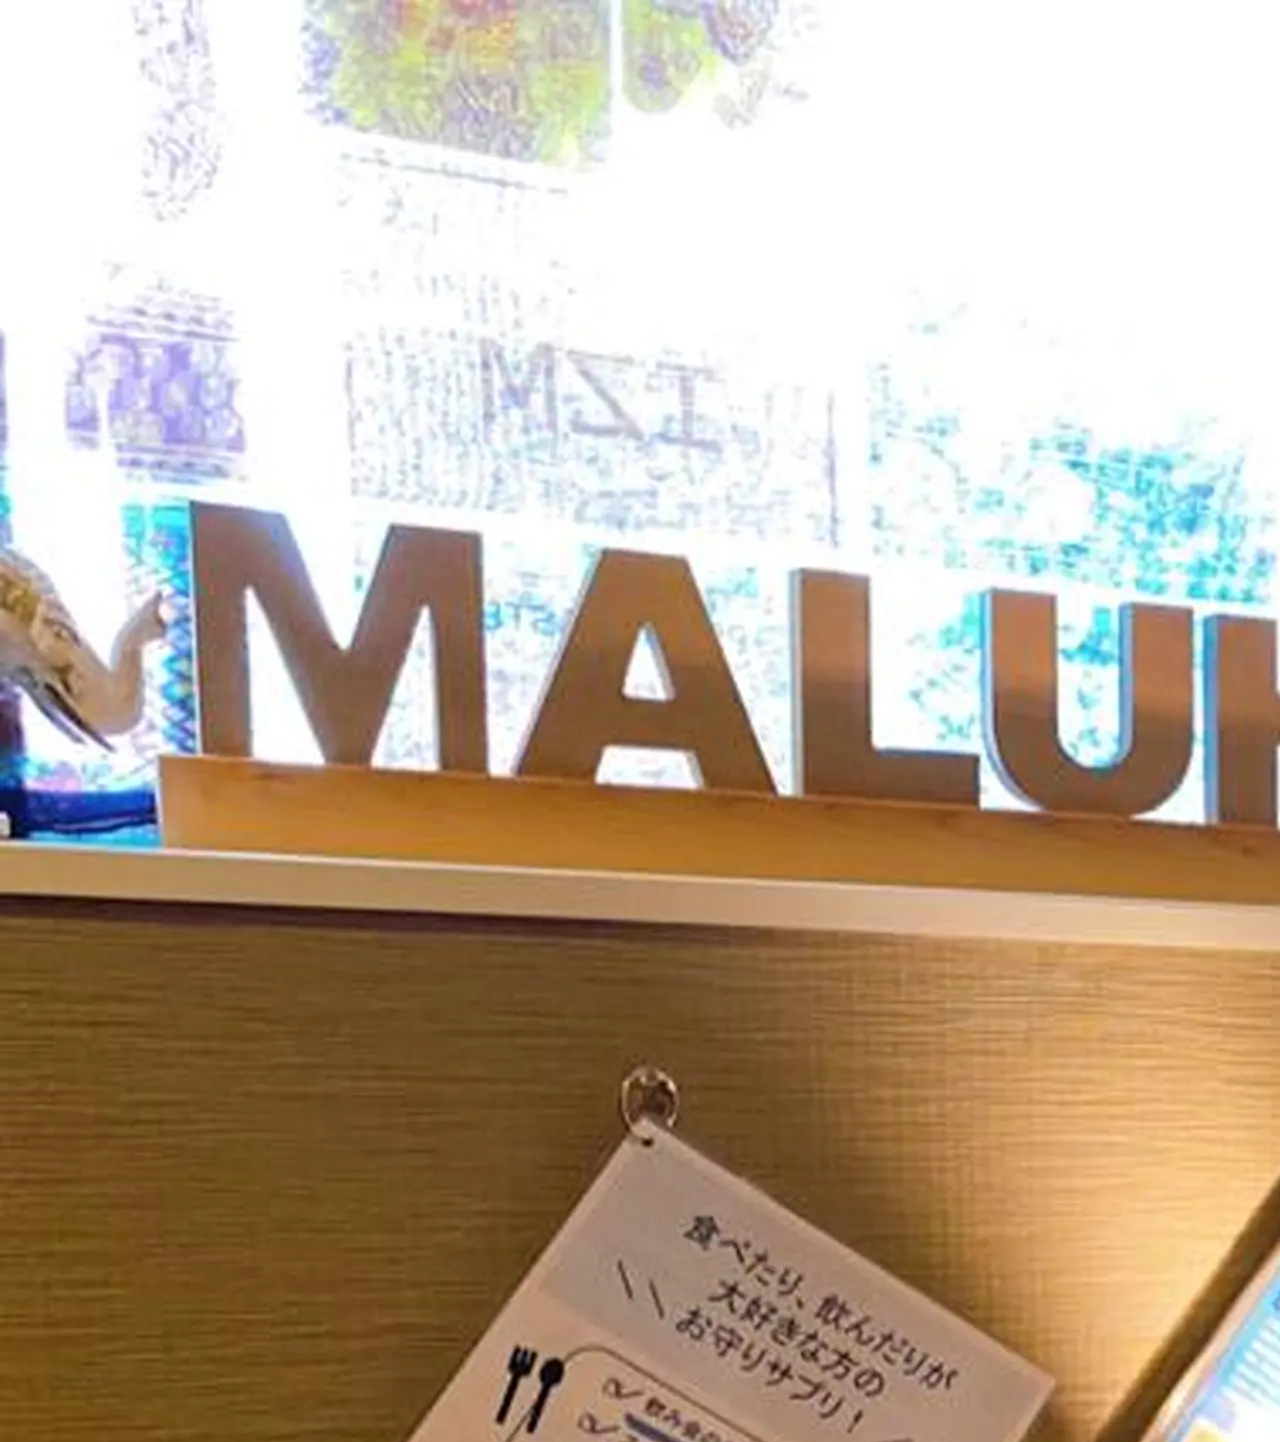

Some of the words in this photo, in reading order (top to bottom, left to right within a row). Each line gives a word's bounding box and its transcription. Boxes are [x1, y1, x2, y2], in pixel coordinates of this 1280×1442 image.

[683, 1214, 959, 1390] 食べたり、飲んだりが
[707, 1279, 885, 1398] 大好きな方の
